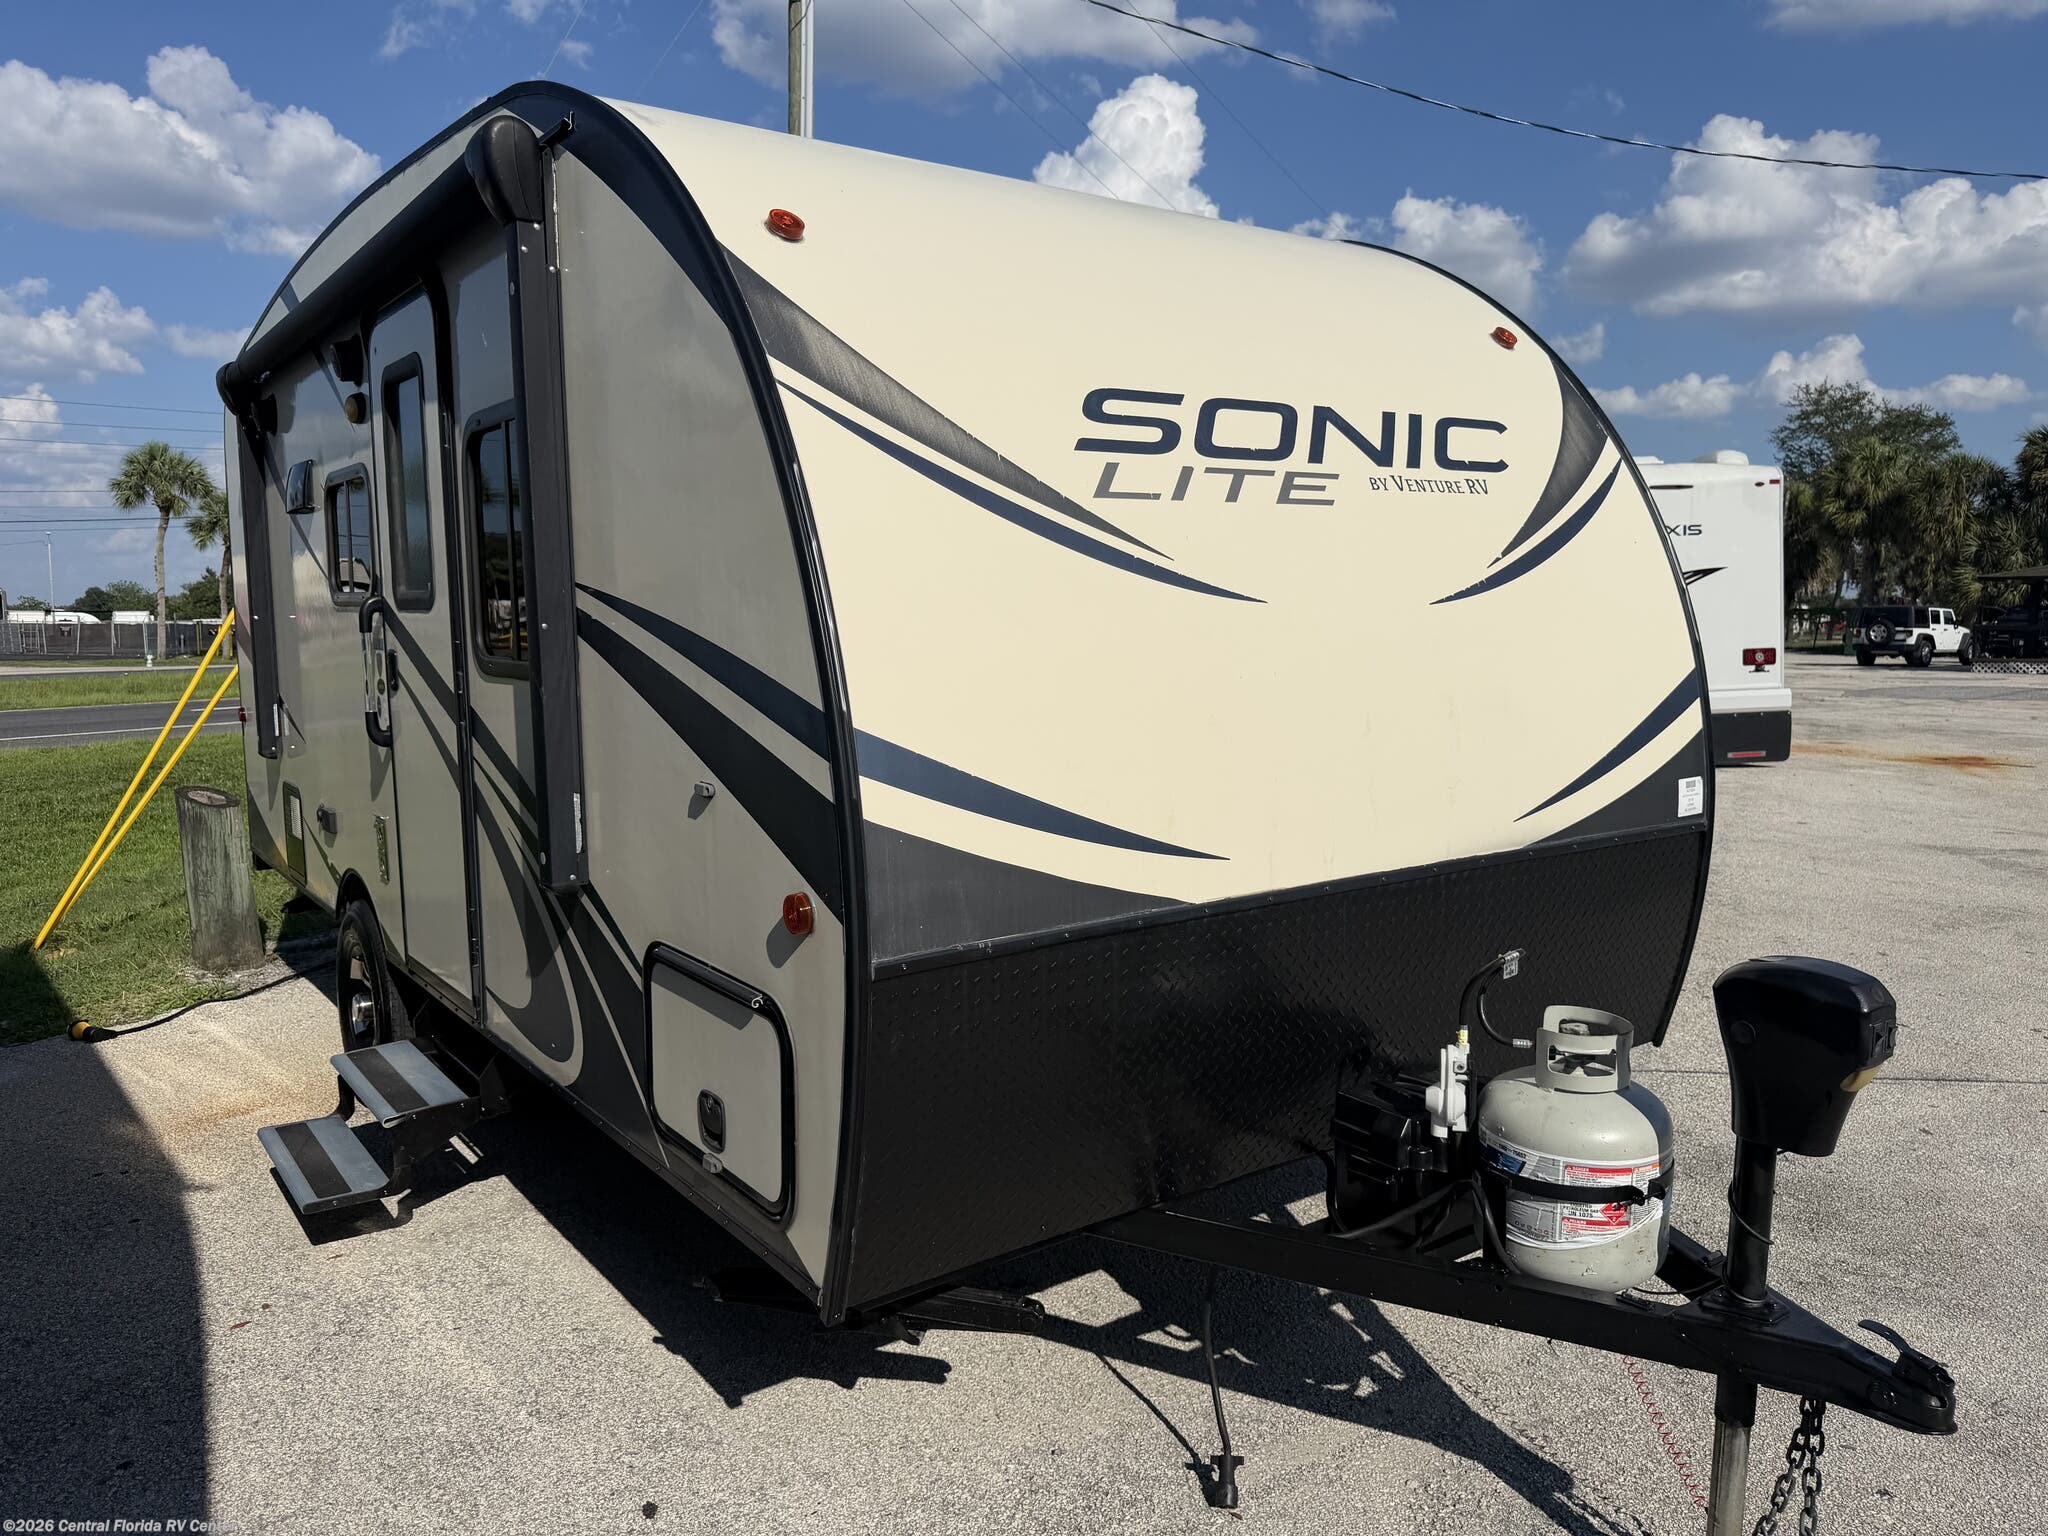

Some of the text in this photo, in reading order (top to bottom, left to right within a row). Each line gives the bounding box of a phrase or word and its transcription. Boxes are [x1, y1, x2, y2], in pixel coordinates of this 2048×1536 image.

[1074, 388, 1508, 473] SONIC
[1093, 462, 1340, 506] LITE
[1465, 478, 1489, 496] RV
